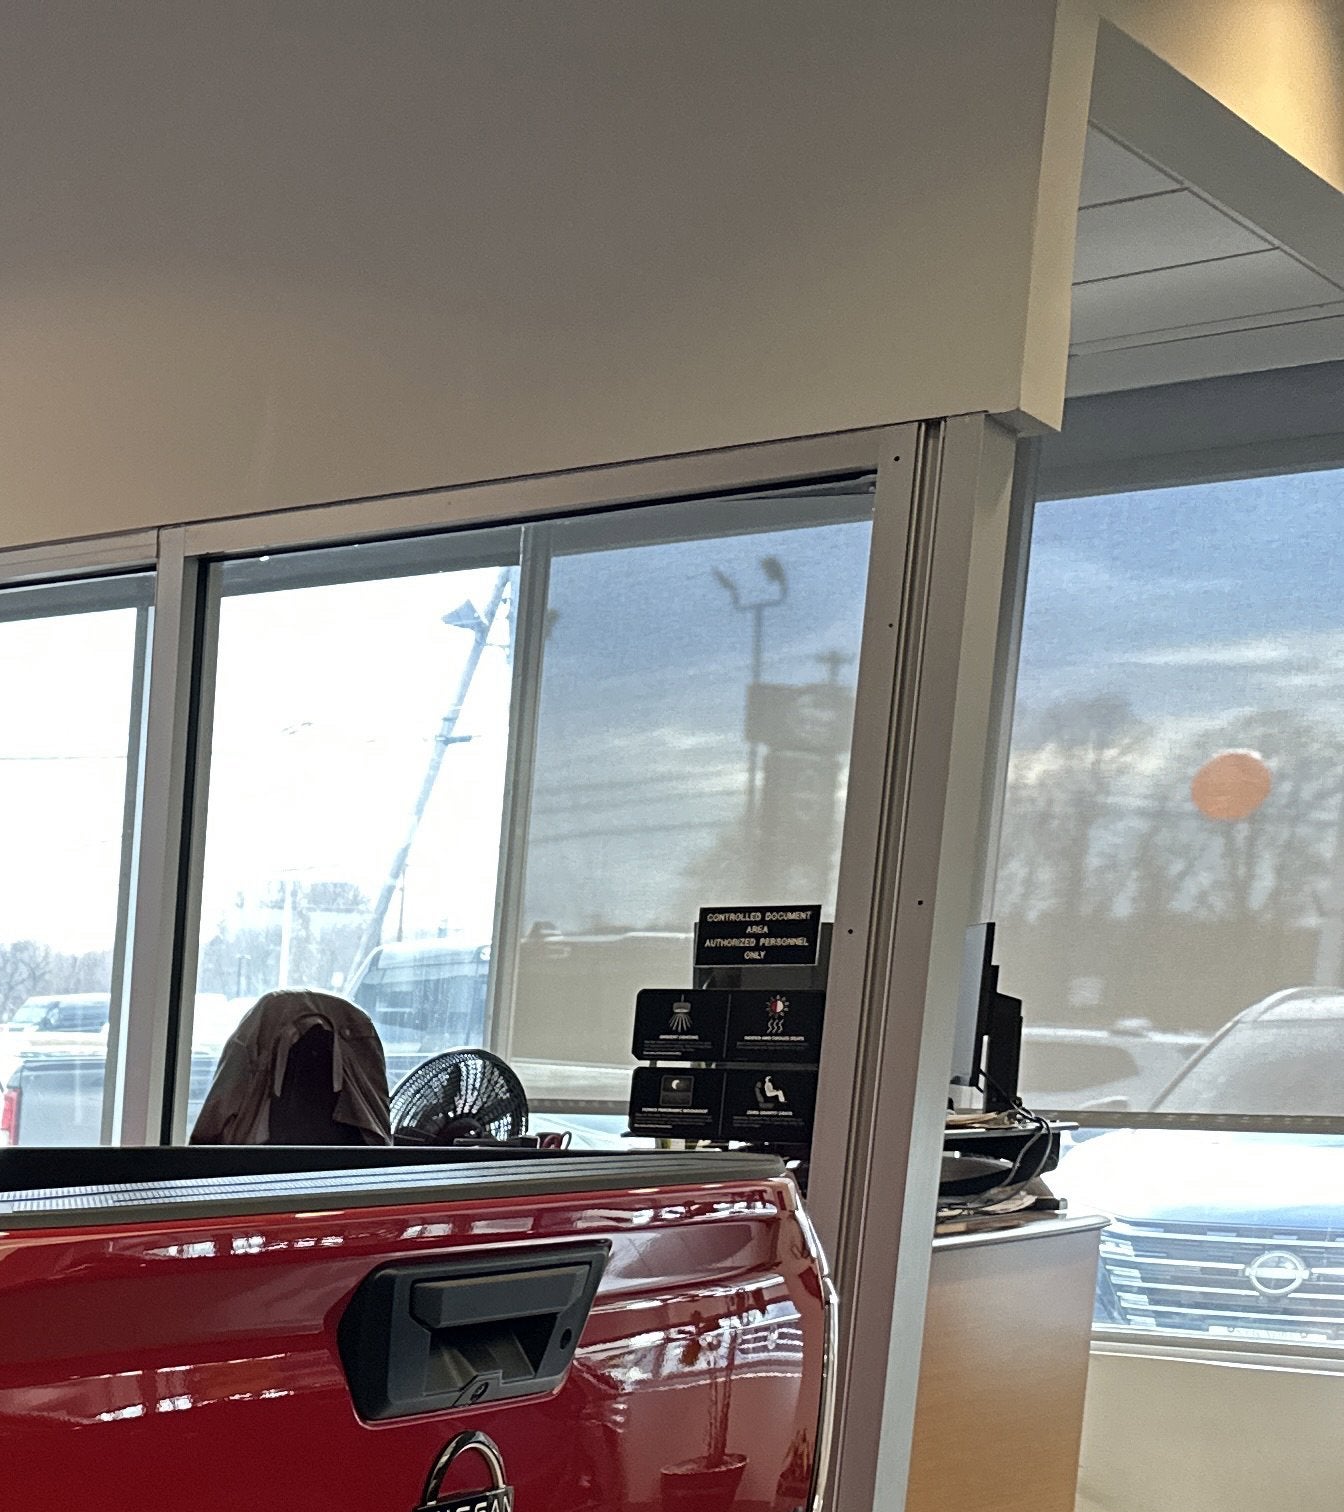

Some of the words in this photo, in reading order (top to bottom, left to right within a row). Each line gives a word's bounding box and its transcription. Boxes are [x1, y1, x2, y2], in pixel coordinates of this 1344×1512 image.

[706, 912, 762, 922] CONTROLLED
[765, 911, 812, 921] DOCUMENT
[746, 925, 769, 934] AREA
[704, 938, 756, 947] AUTHORIZED
[759, 937, 809, 946] PERSONNEL
[744, 951, 766, 960] ONLY
